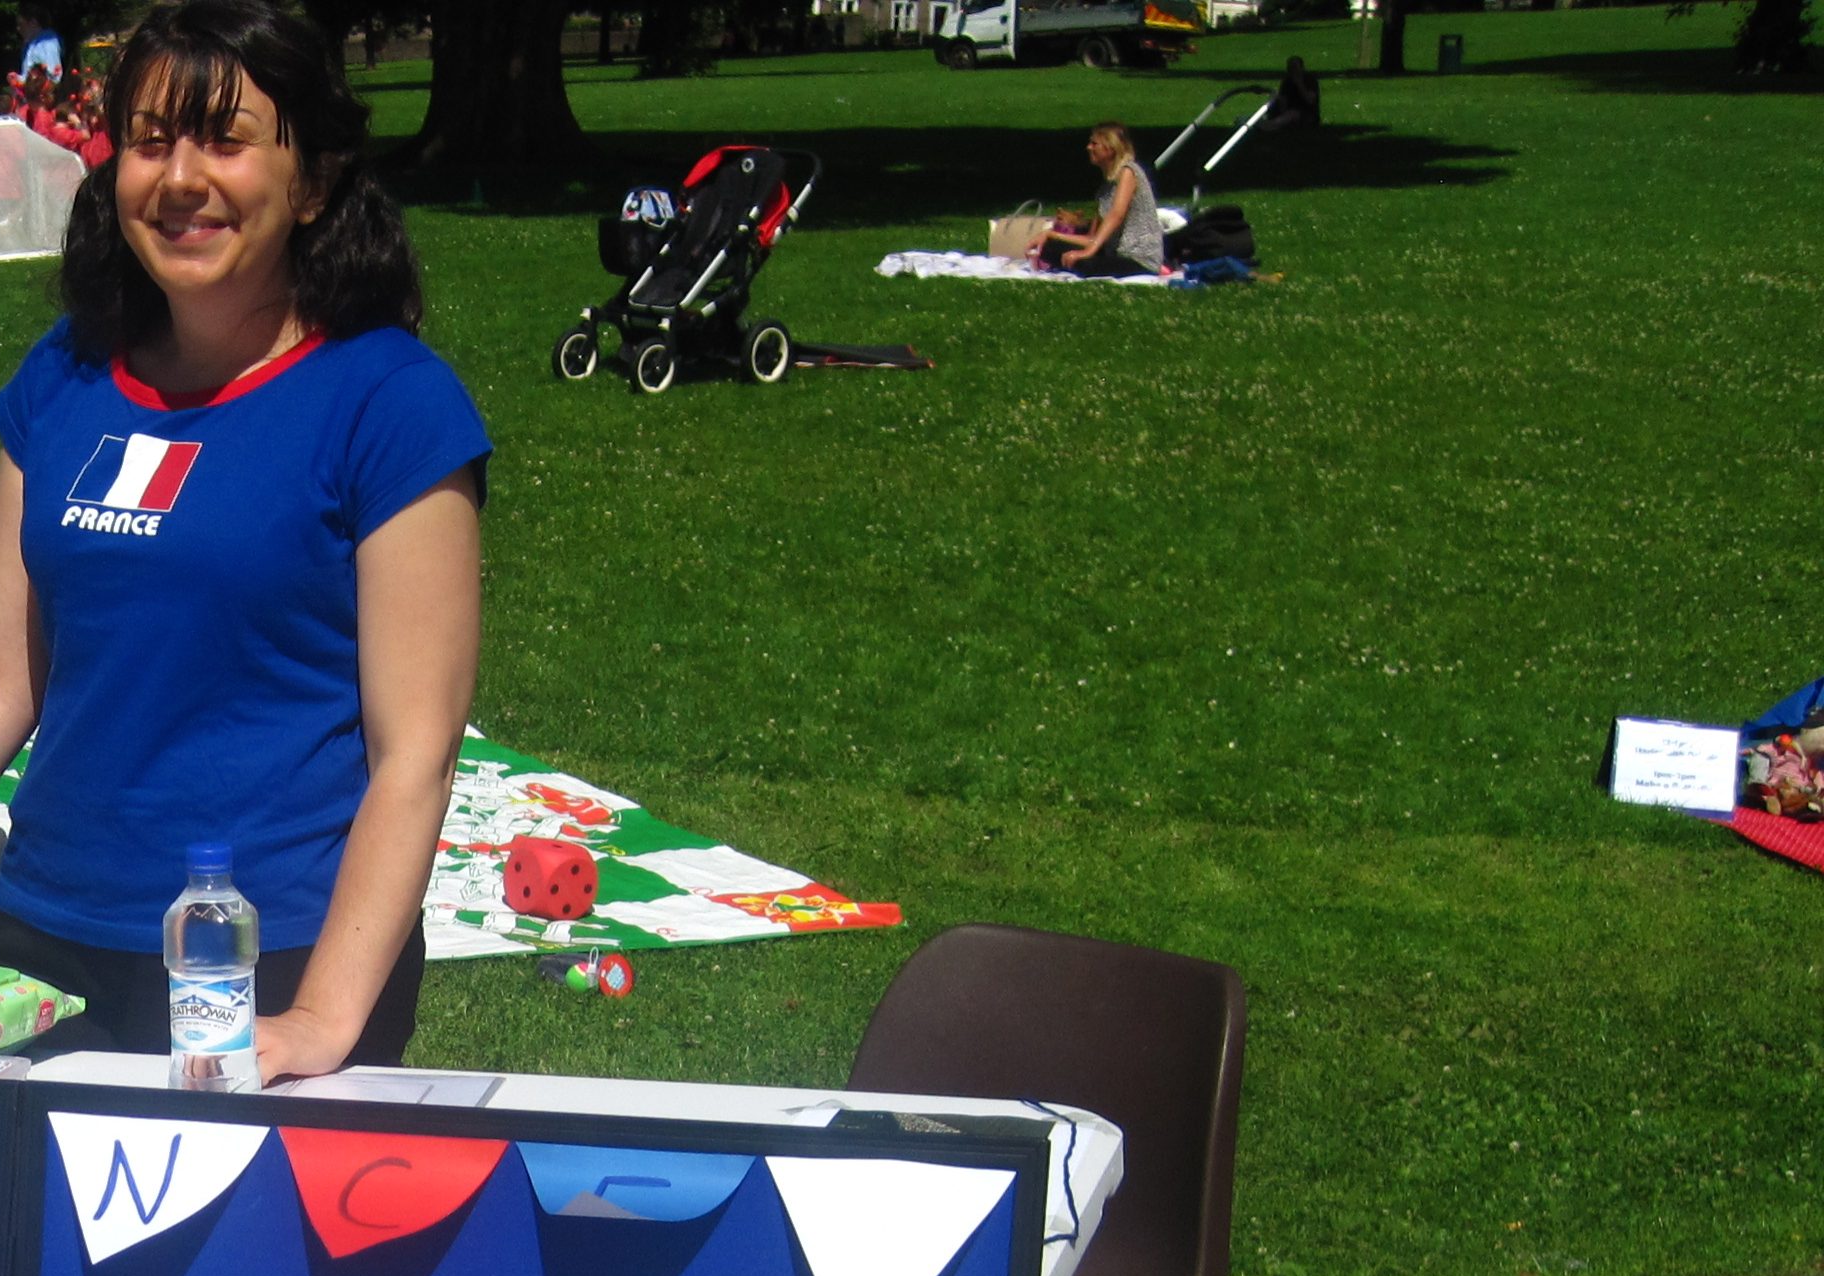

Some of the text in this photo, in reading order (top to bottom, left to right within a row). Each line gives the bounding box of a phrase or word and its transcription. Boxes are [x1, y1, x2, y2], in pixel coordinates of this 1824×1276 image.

[61, 506, 162, 536] FRANCE
[93, 1134, 180, 1224] N
[339, 1158, 412, 1229] C
